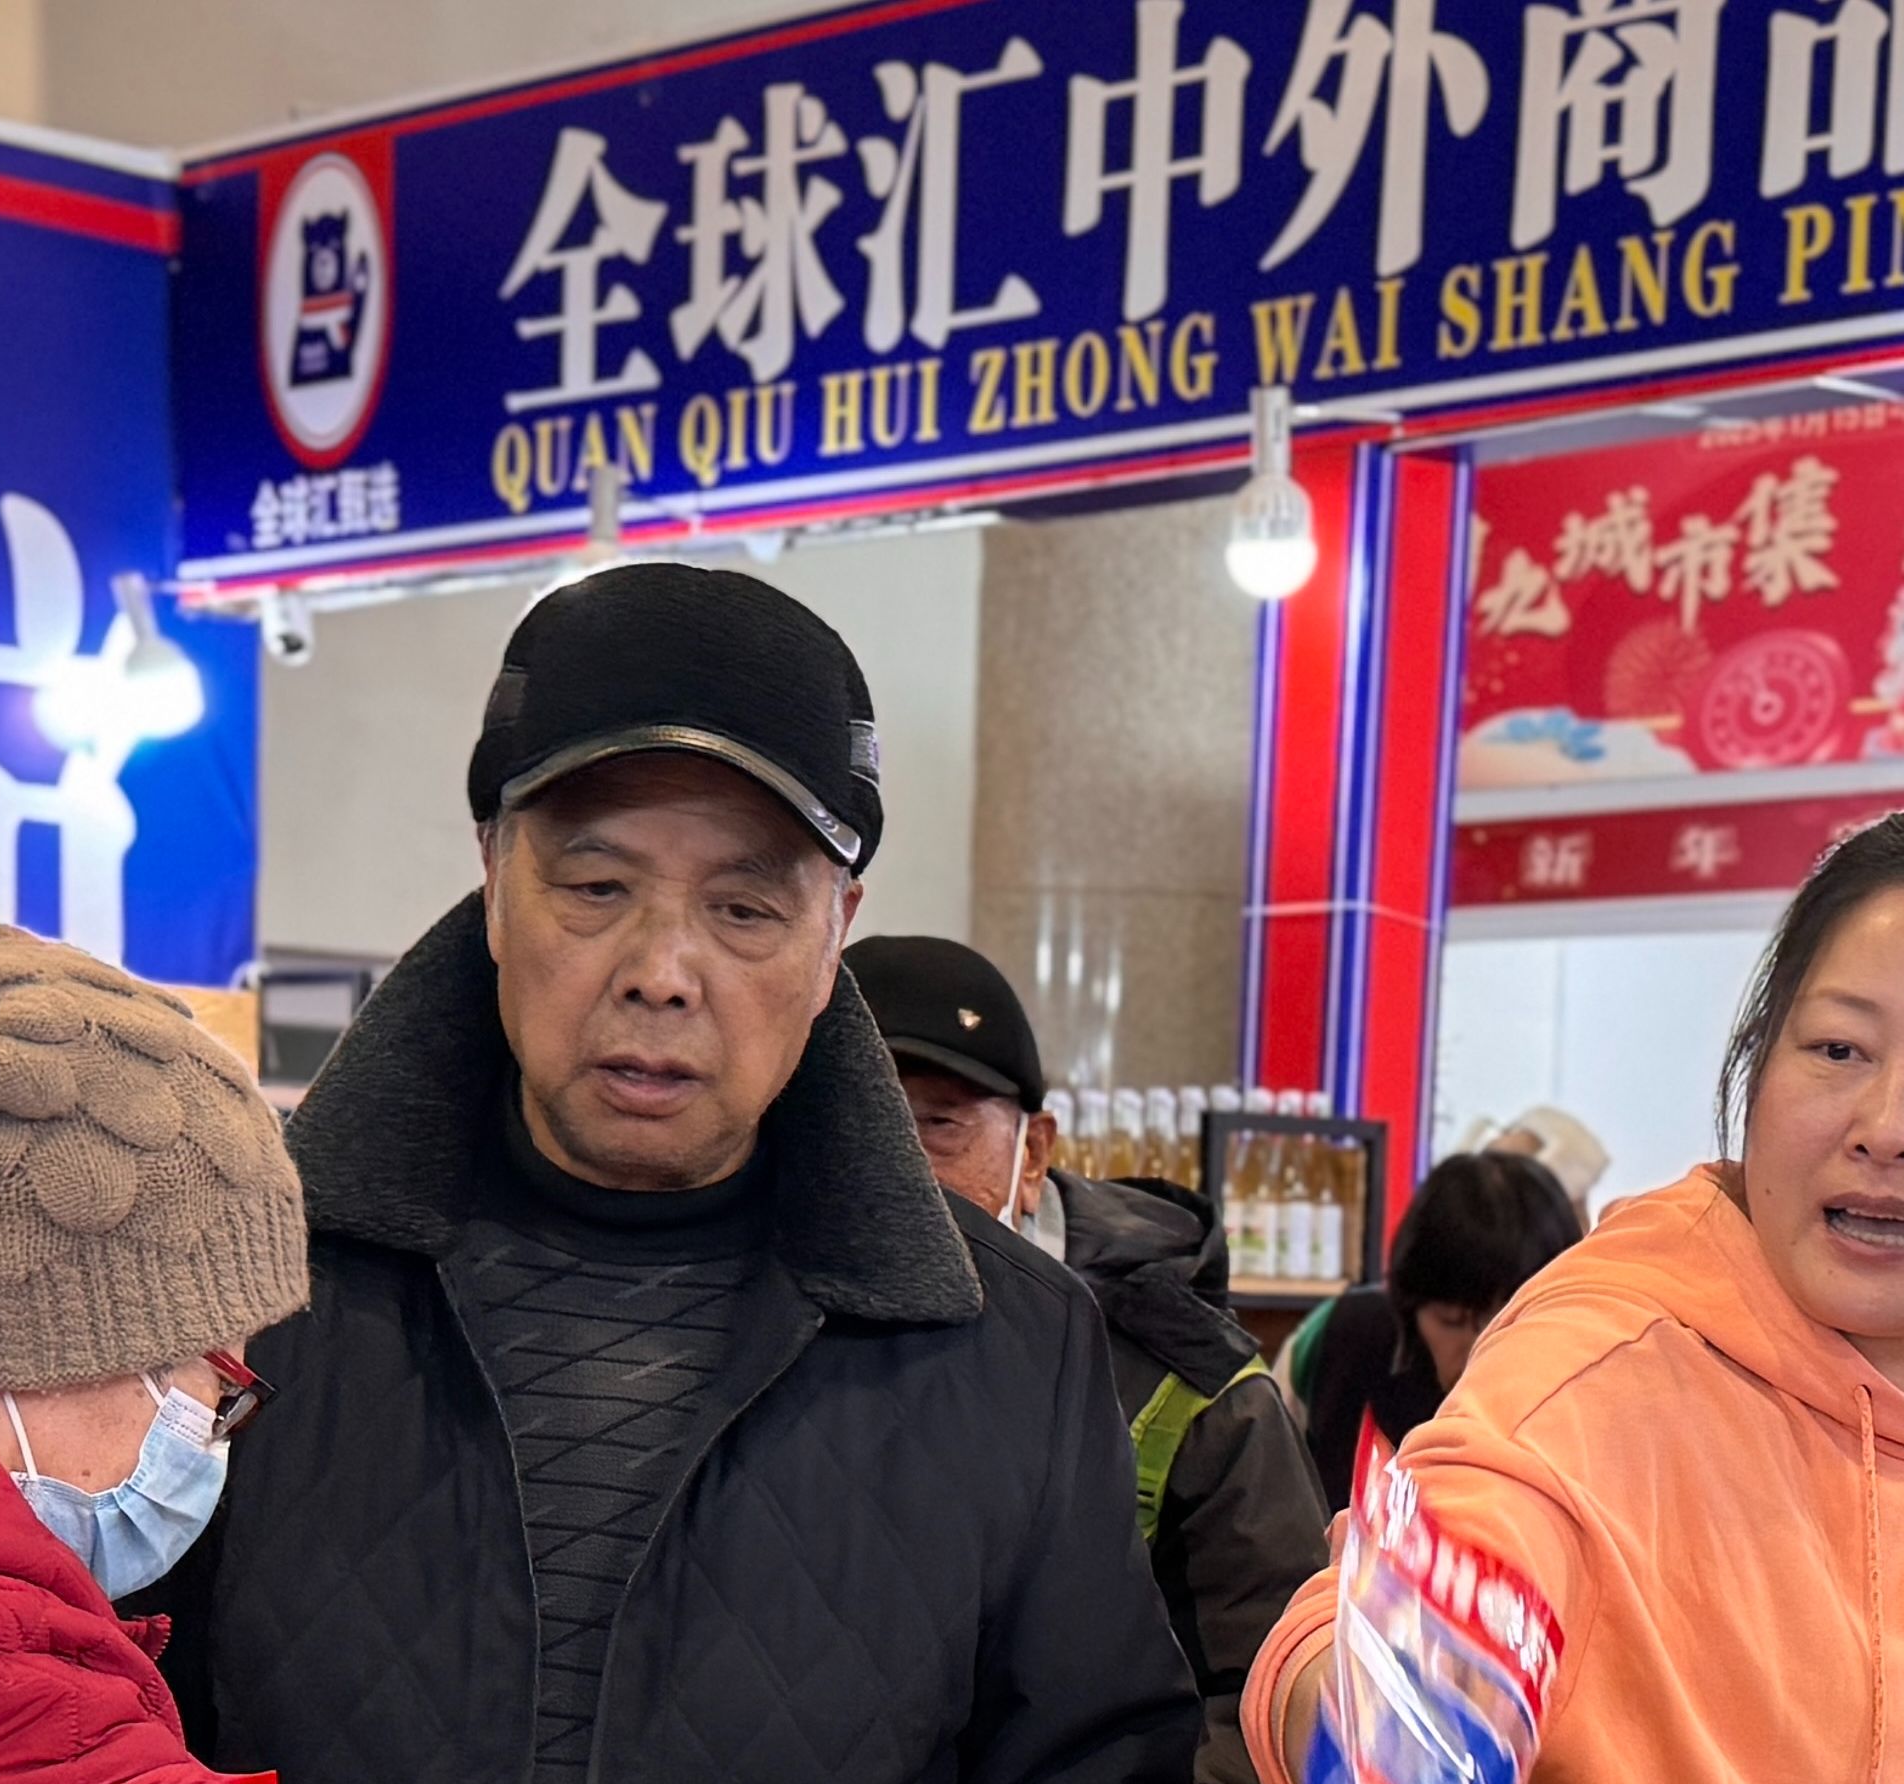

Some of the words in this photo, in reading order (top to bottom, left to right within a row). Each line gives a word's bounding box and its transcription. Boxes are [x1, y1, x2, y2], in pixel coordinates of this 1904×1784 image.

[492, 405, 658, 514] QUAN
[678, 382, 797, 488] QIU
[818, 359, 942, 456] HUI
[967, 313, 1218, 435] ZHONG
[1250, 278, 1404, 387] WAI
[1438, 219, 1740, 360] SHANG
